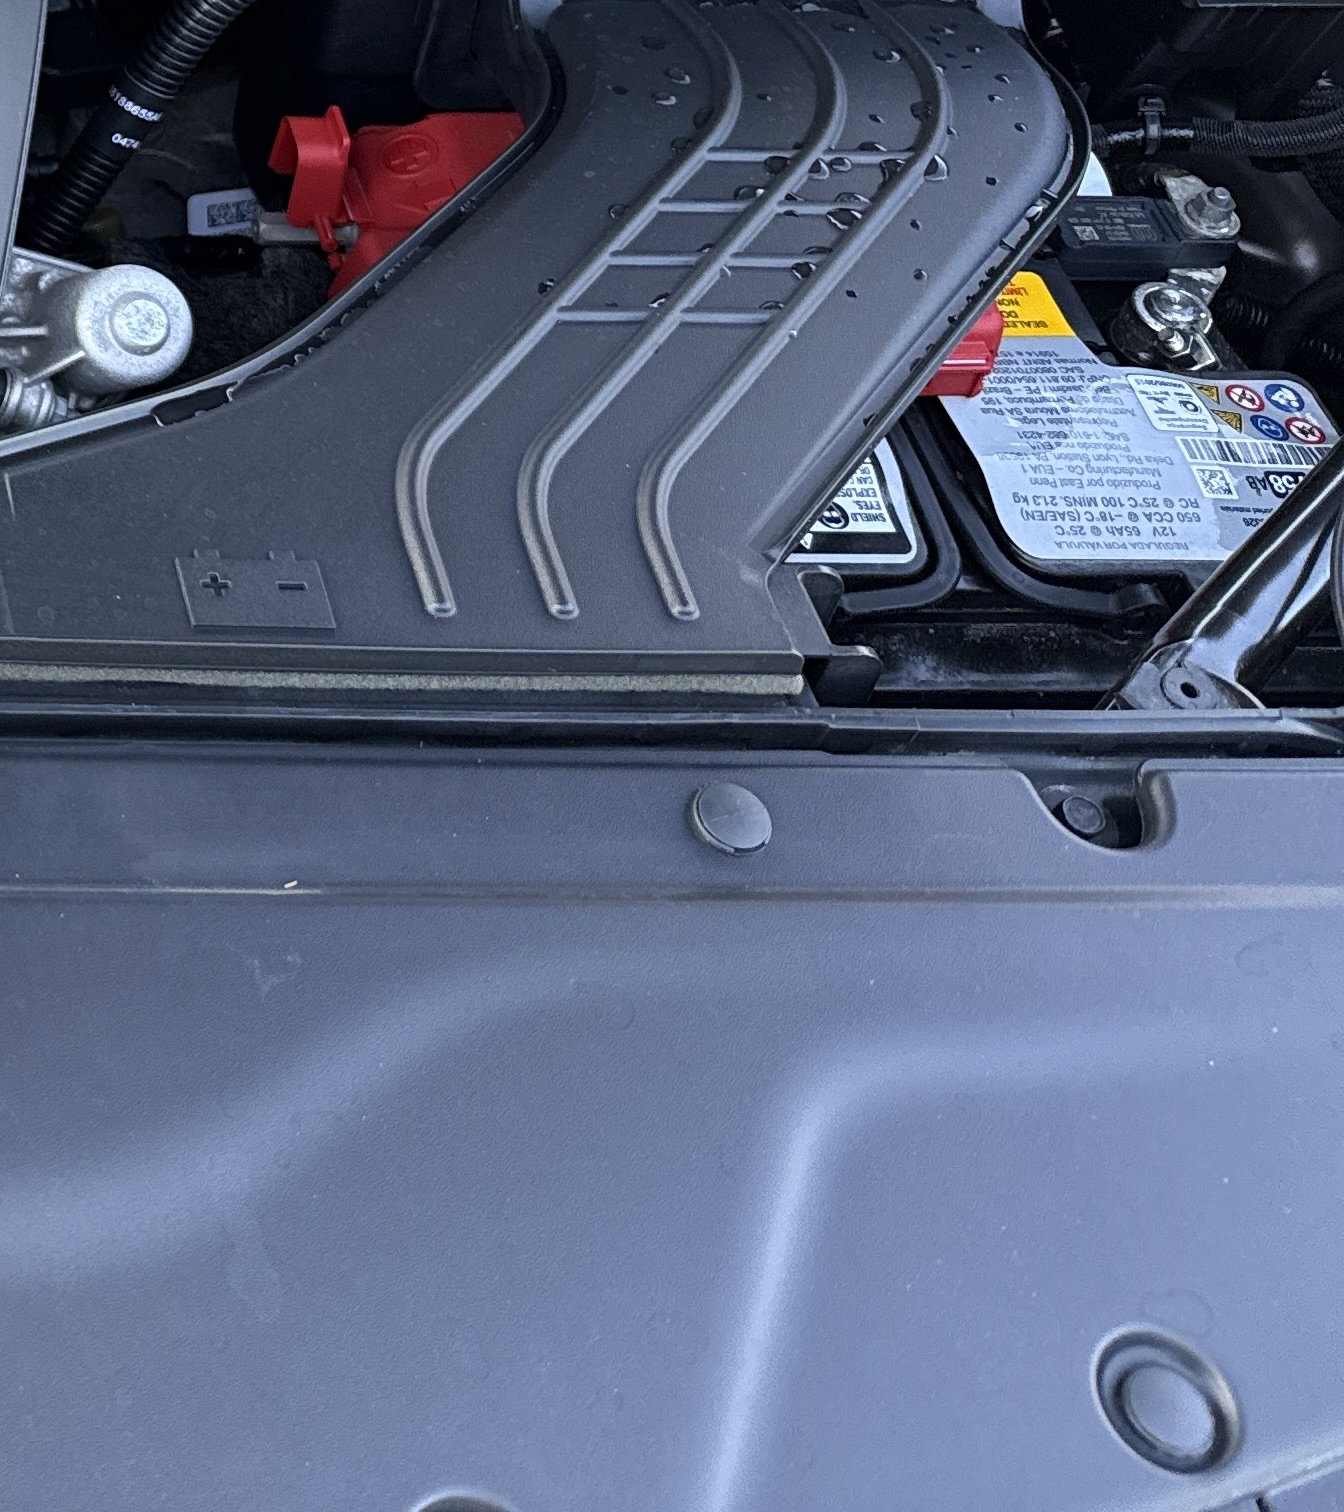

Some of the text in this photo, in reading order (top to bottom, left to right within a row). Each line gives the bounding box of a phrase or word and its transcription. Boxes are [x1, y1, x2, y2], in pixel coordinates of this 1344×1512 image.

[1023, 386, 1041, 394] PE
[1005, 407, 1024, 416] SA
[1024, 407, 1061, 416] Moura
[1090, 452, 1118, 464] Lyon
[1143, 455, 1174, 466] Deka
[1021, 464, 1028, 474] 1
[1029, 464, 1055, 475] EUA
[1065, 464, 1085, 475] Co.
[1085, 463, 1162, 478] Manufacturing
[1029, 476, 1162, 491] Produzido por East Penn
[1245, 476, 1268, 491] AB
[1011, 492, 1200, 509] RC @ 25°C 100 MINS. 21.3 kg
[850, 512, 887, 523] SHIELD
[1020, 507, 1081, 522] (SAE/EN)
[1127, 511, 1139, 522] @
[1142, 511, 1173, 523] CCA
[1176, 511, 1201, 523] 650
[1054, 525, 1176, 537] 12V 65Ah @ 25°C
[1103, 541, 1127, 550] POR
[1131, 541, 1189, 551] REGULADA
